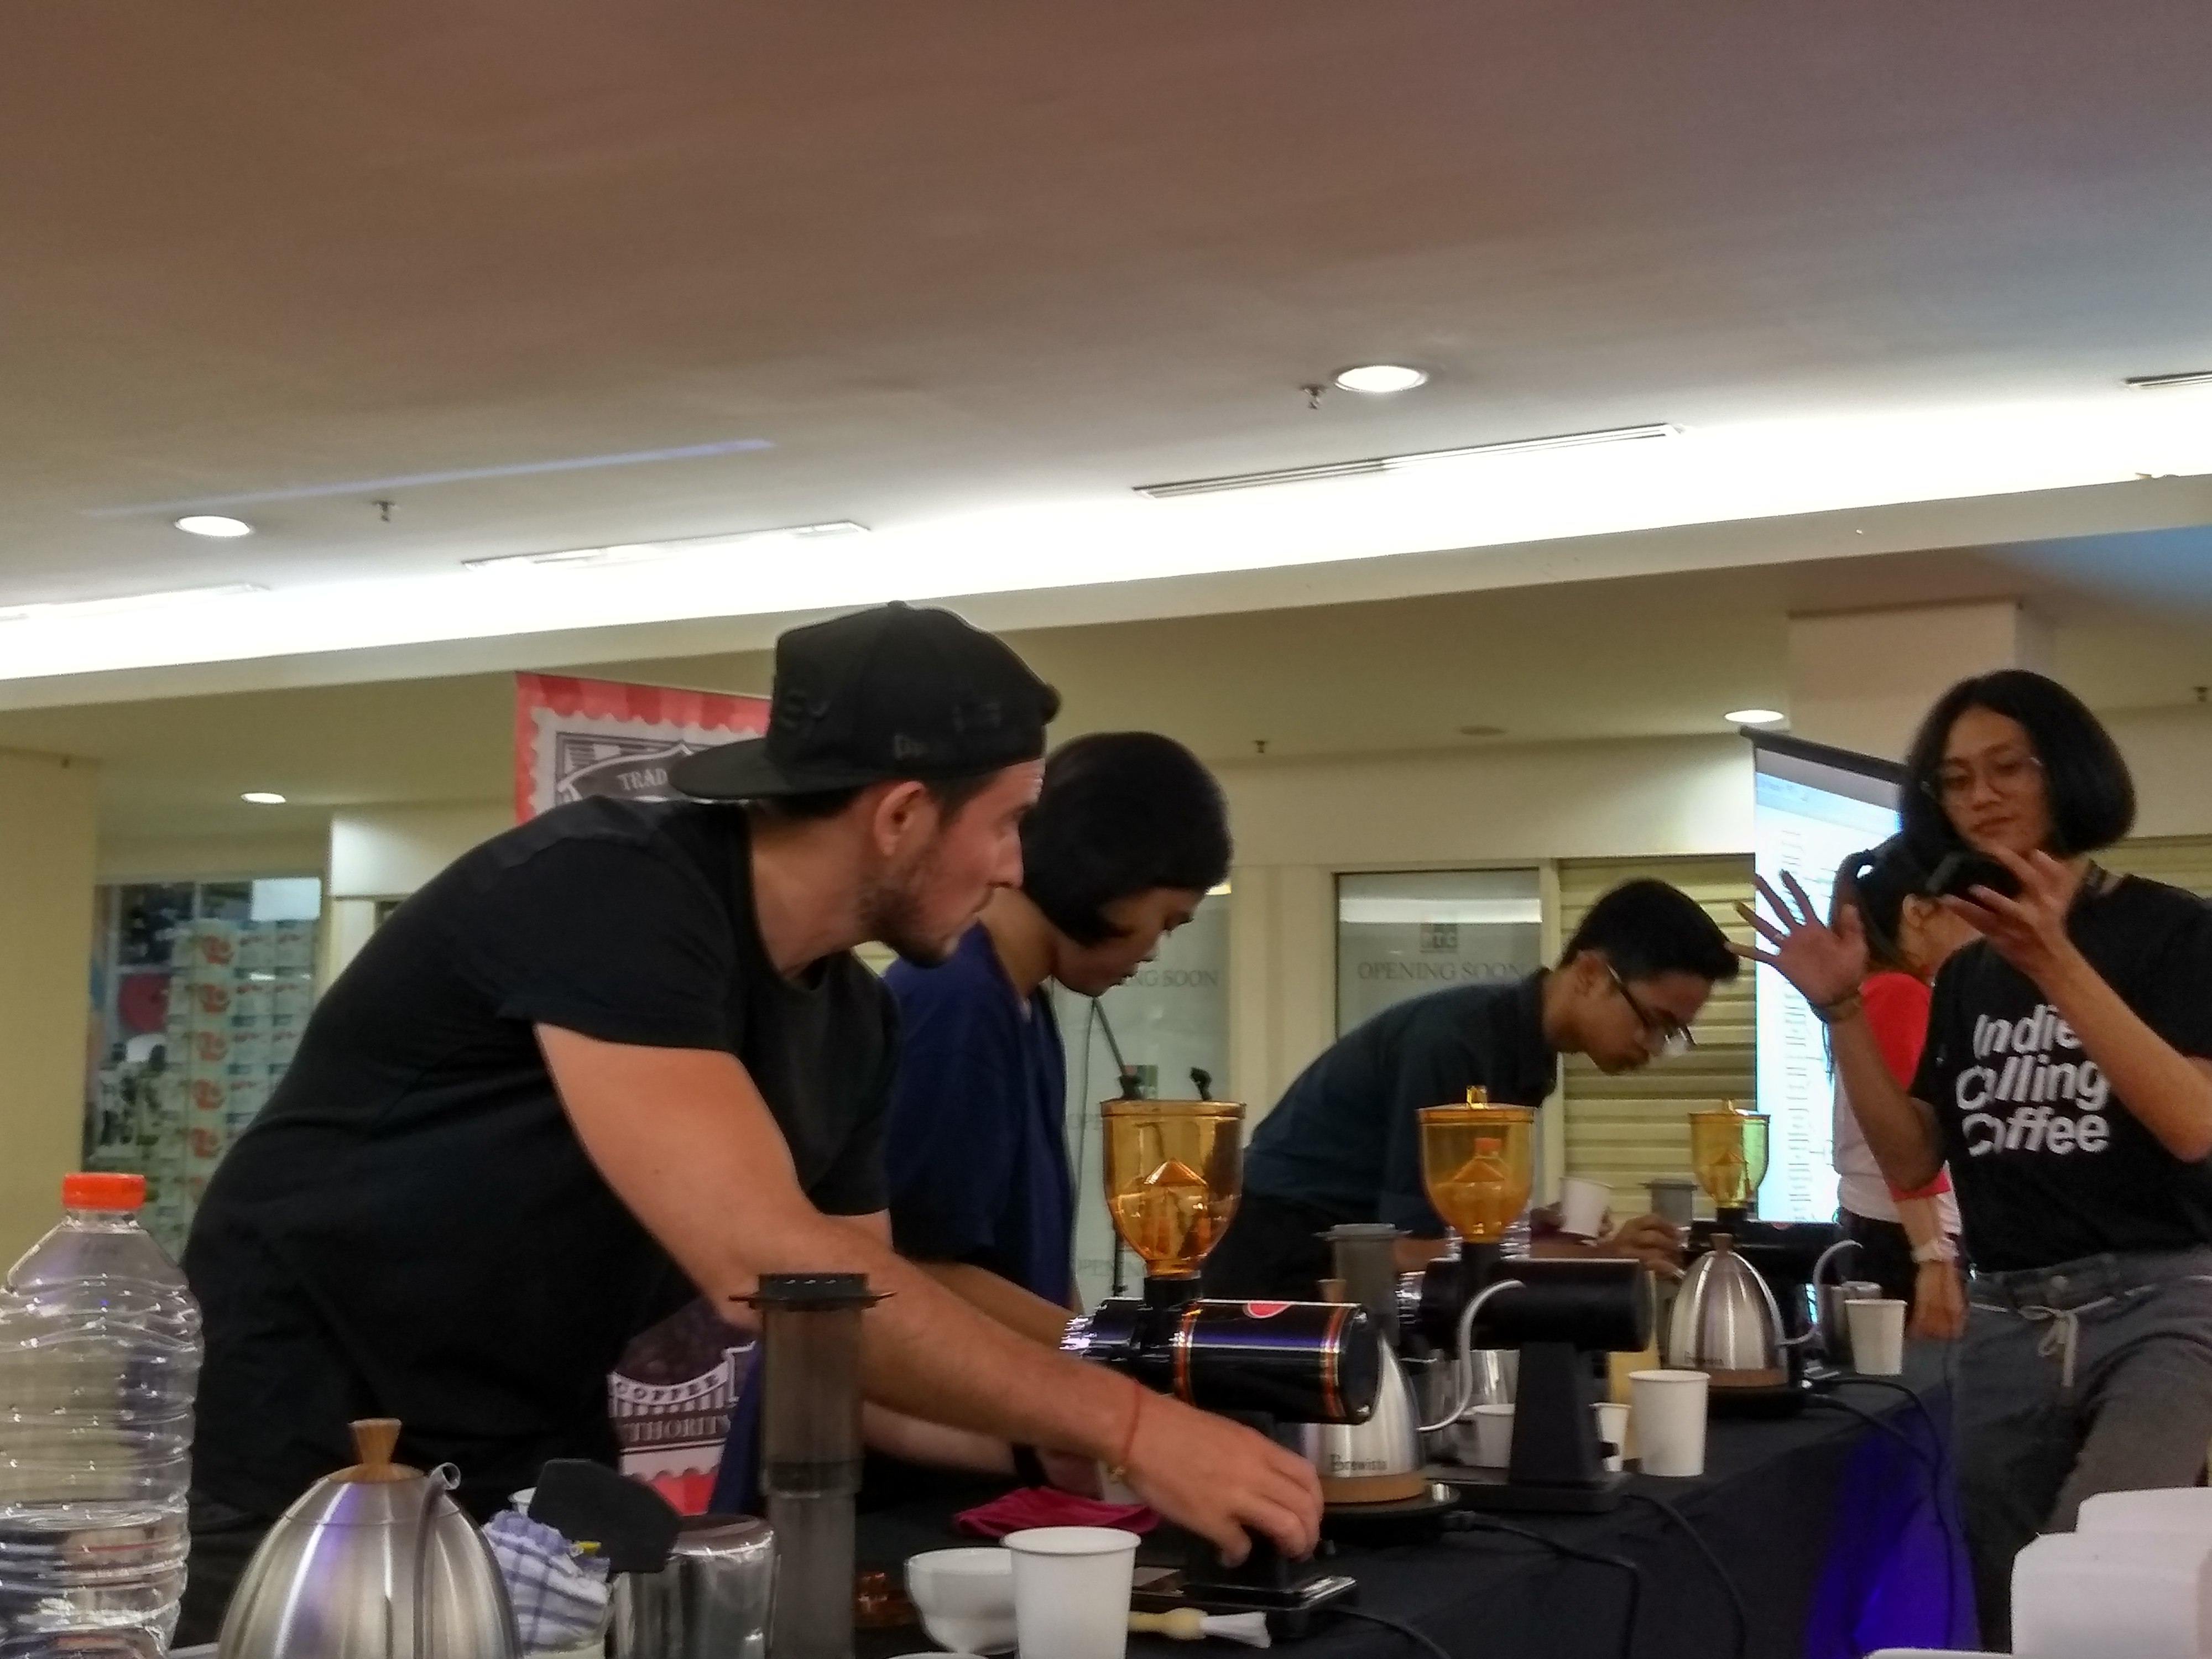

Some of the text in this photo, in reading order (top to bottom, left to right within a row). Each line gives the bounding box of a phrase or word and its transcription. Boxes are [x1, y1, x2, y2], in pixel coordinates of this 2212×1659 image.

[616, 767, 669, 791] TRAD
[1162, 969, 1218, 987] SOON
[1357, 961, 1456, 980] OPENING
